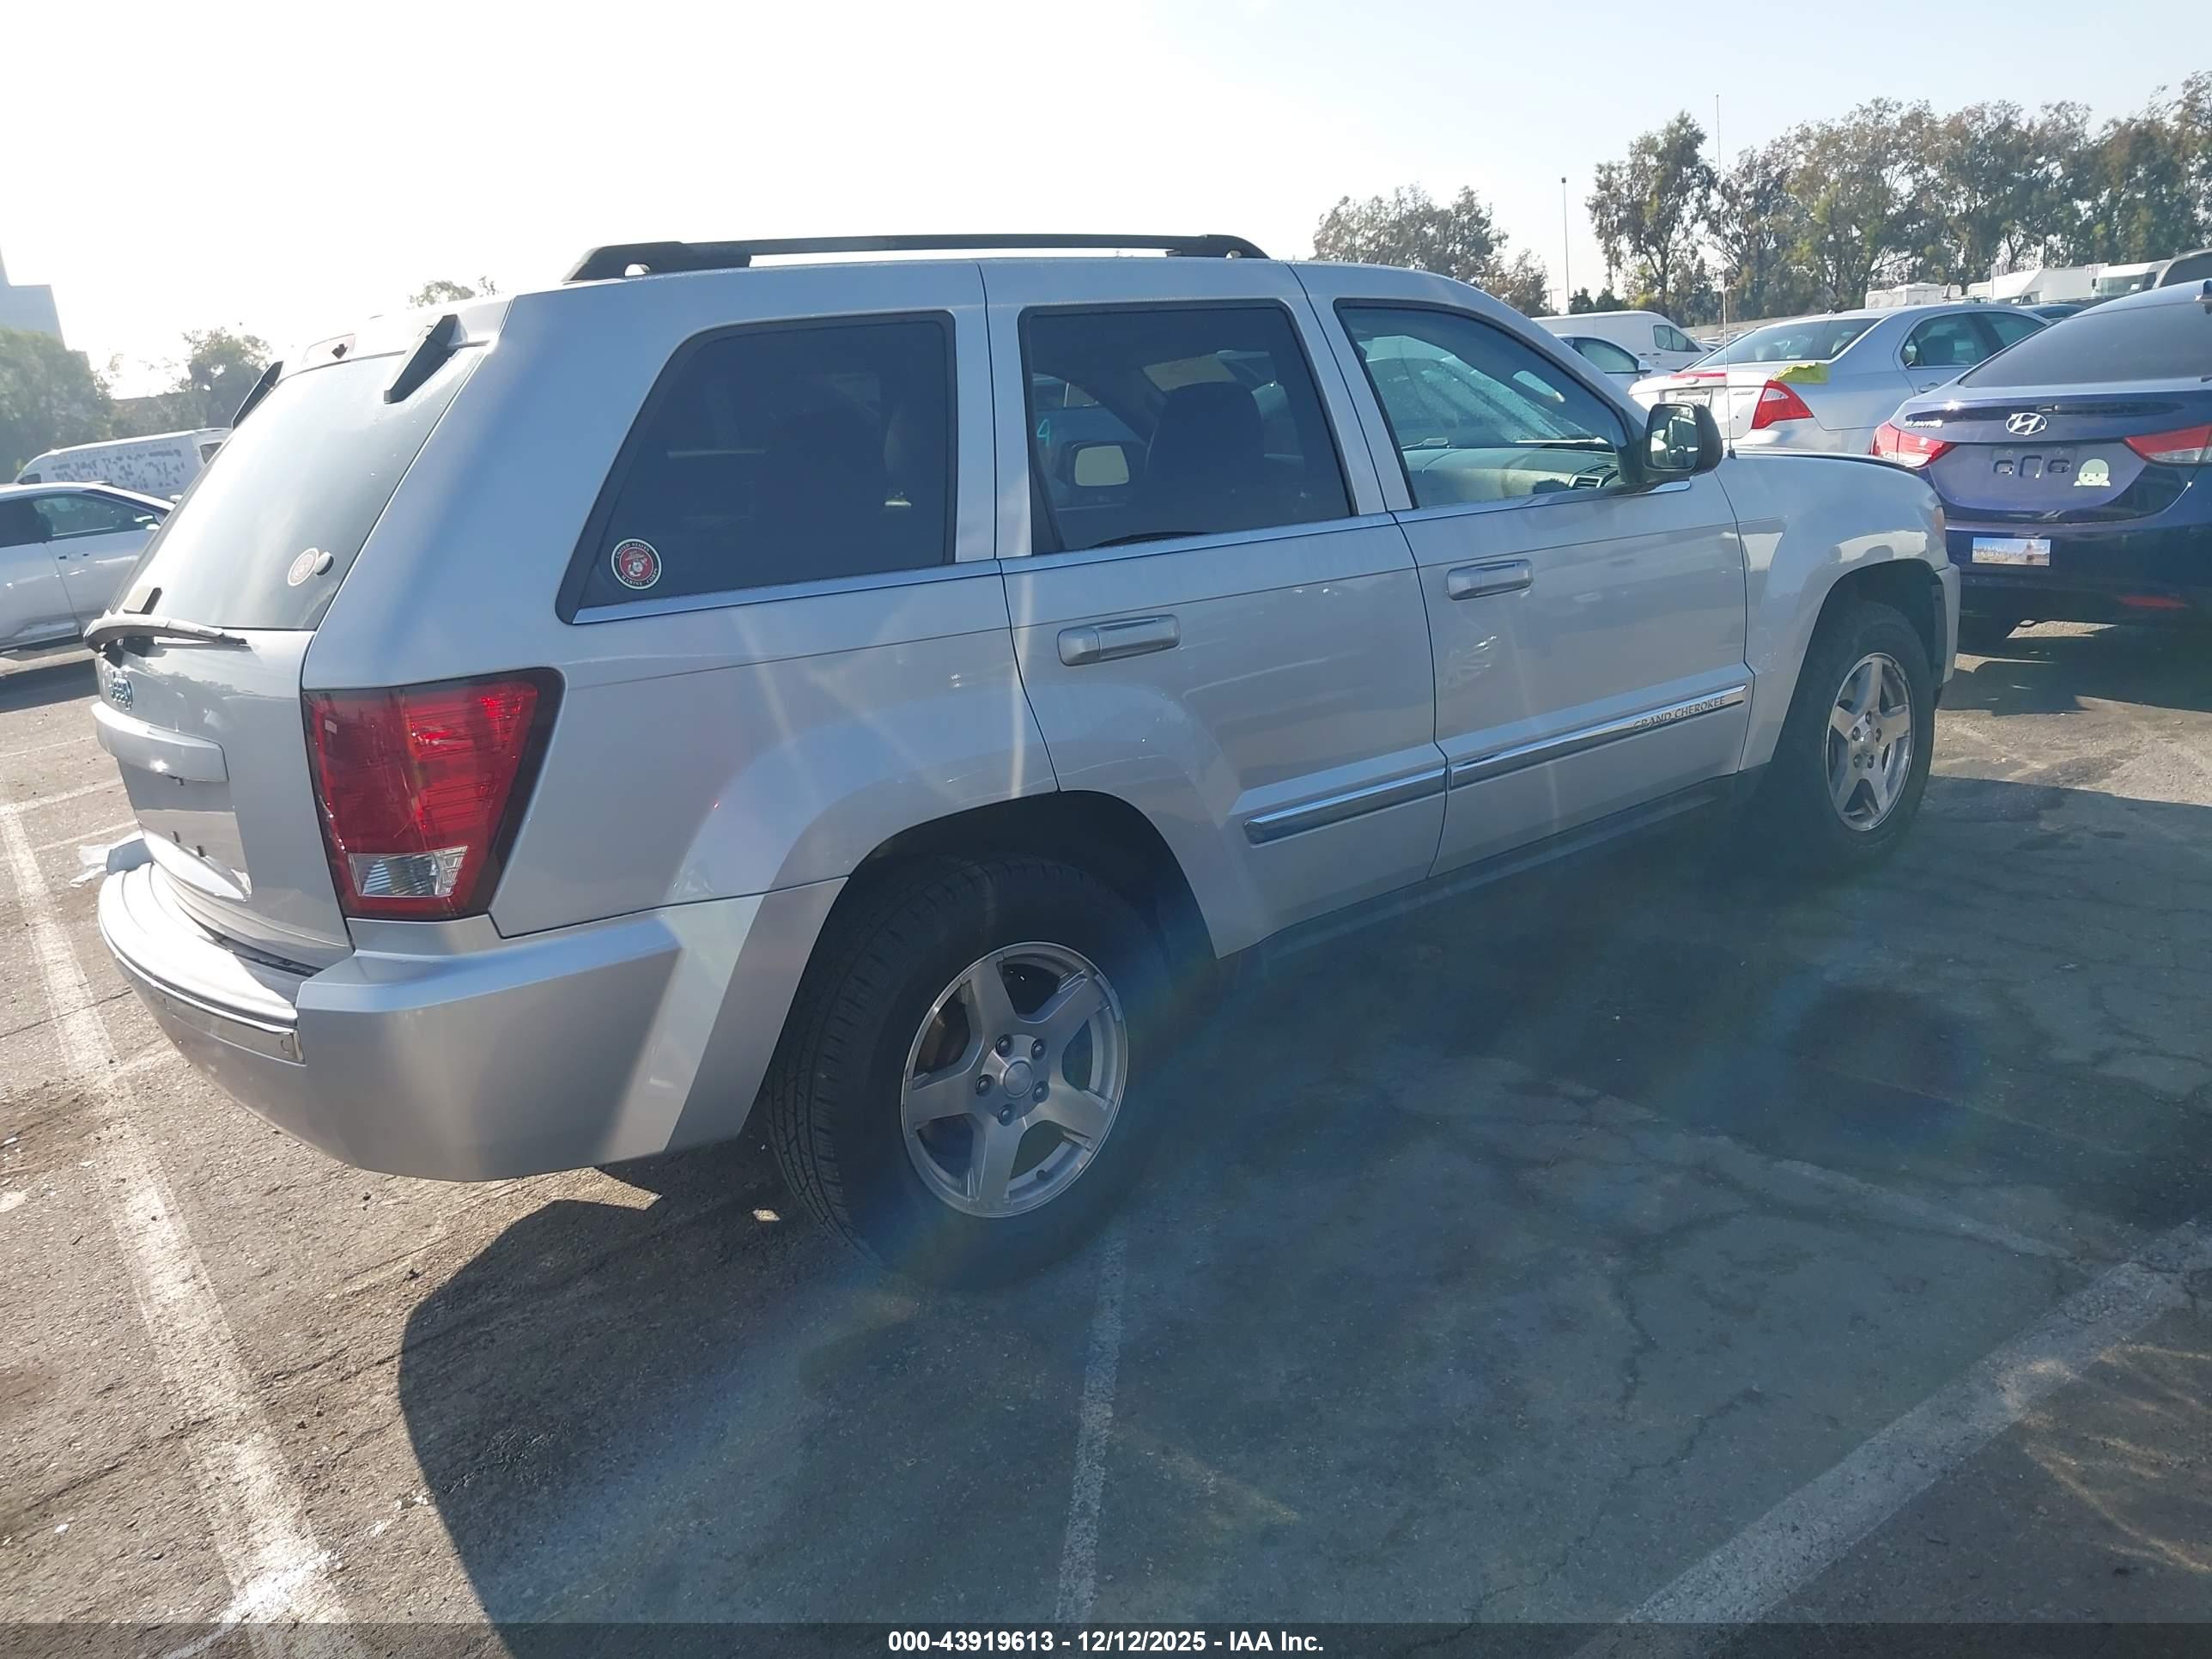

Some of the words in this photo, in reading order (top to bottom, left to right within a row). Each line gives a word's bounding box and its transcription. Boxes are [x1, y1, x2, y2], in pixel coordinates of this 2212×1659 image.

[621, 574, 643, 586] MARINE
[1634, 711, 1672, 730] GRAND
[1674, 696, 1726, 719] CHEROKEE
